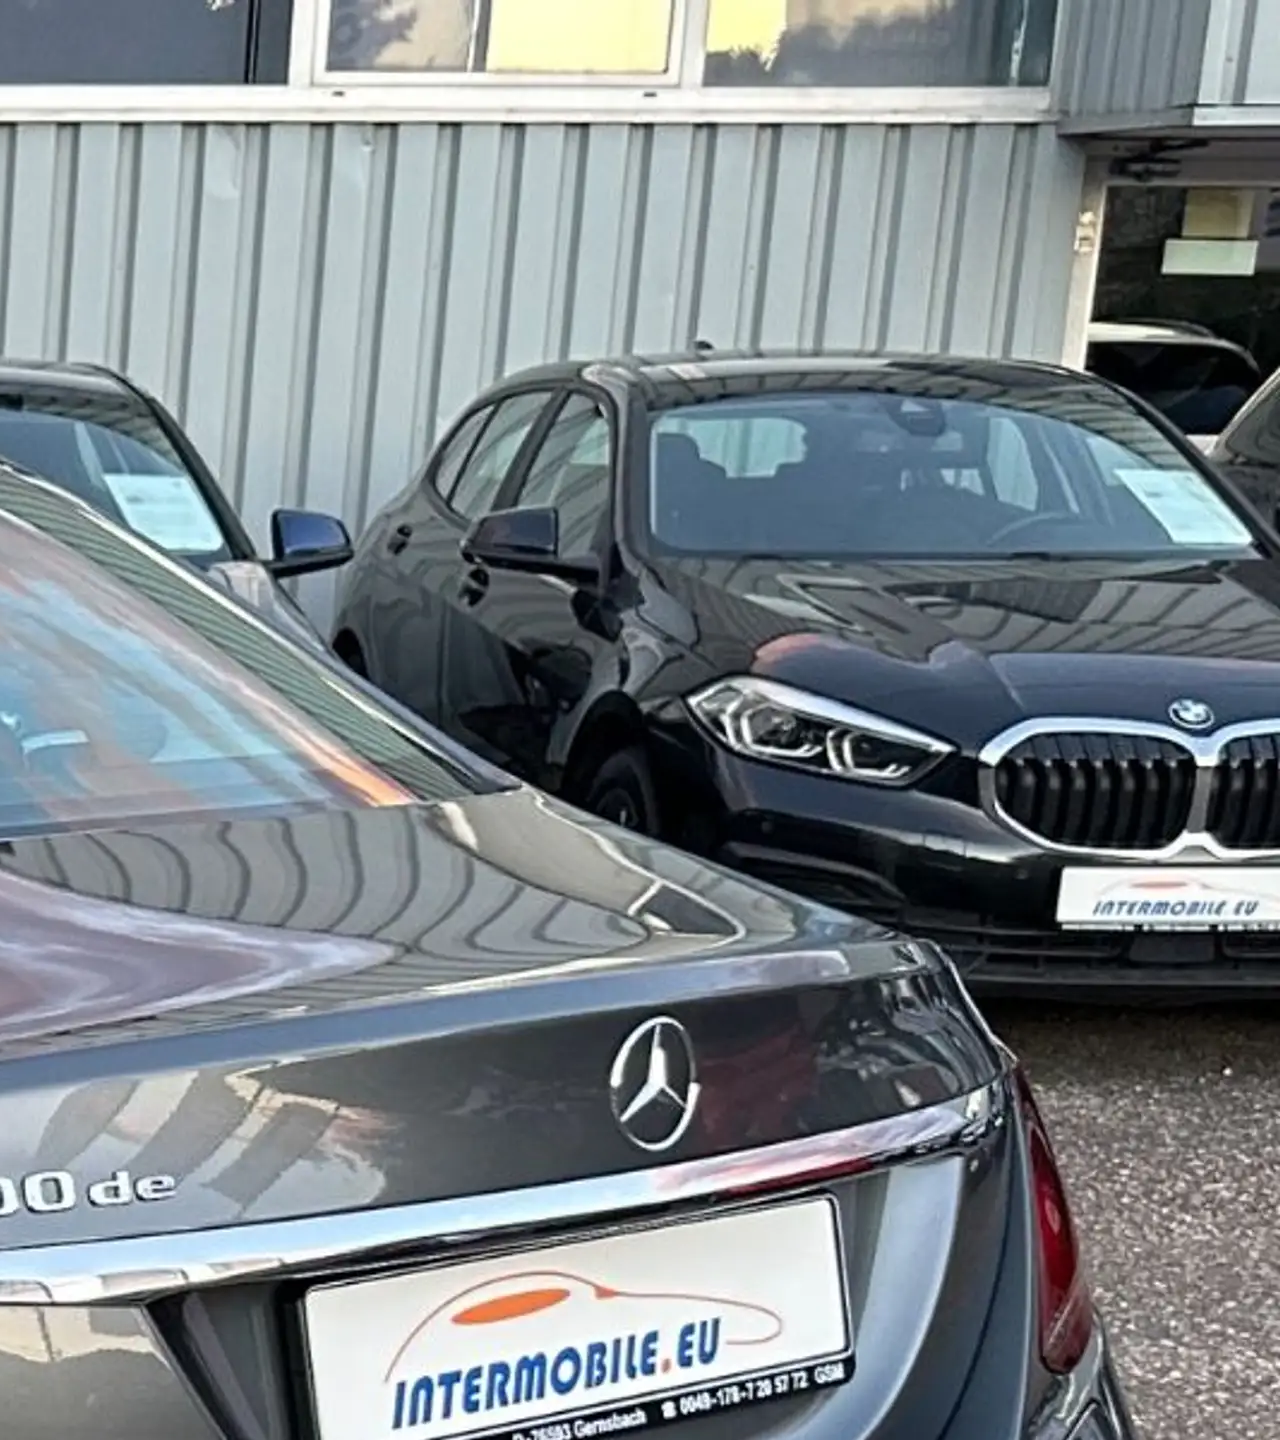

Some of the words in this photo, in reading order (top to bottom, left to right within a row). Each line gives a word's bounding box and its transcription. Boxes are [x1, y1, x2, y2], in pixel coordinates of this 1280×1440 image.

[87, 1170, 178, 1207] de
[391, 1317, 720, 1430] INTERMOBILE.EU
[573, 1406, 647, 1438] Gernsbach
